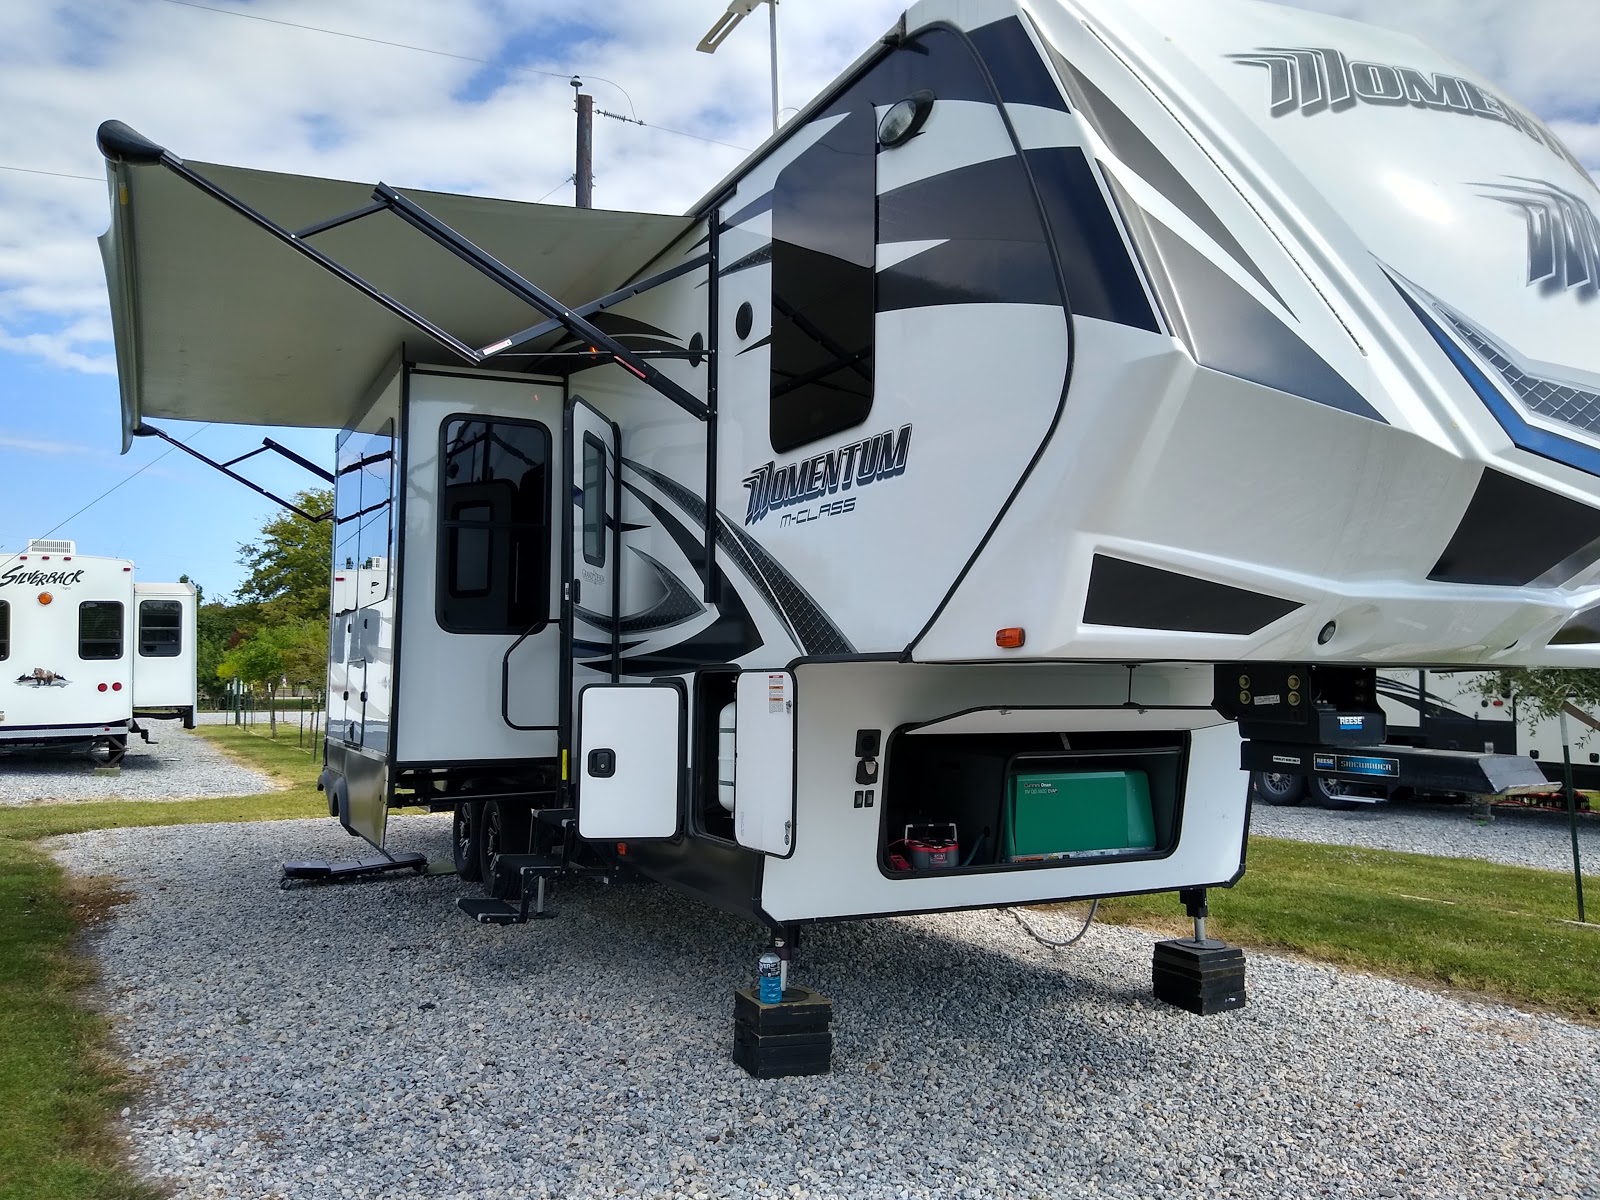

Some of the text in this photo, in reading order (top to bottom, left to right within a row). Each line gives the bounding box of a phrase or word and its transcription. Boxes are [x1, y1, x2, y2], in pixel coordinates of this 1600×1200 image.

[742, 423, 913, 527] MOMENTUM
[780, 497, 857, 528] M-CLASS
[0, 564, 85, 588] SILVERBACK
[1339, 716, 1363, 725] REESE
[1316, 757, 1392, 771] REESE SIDEWINDER
